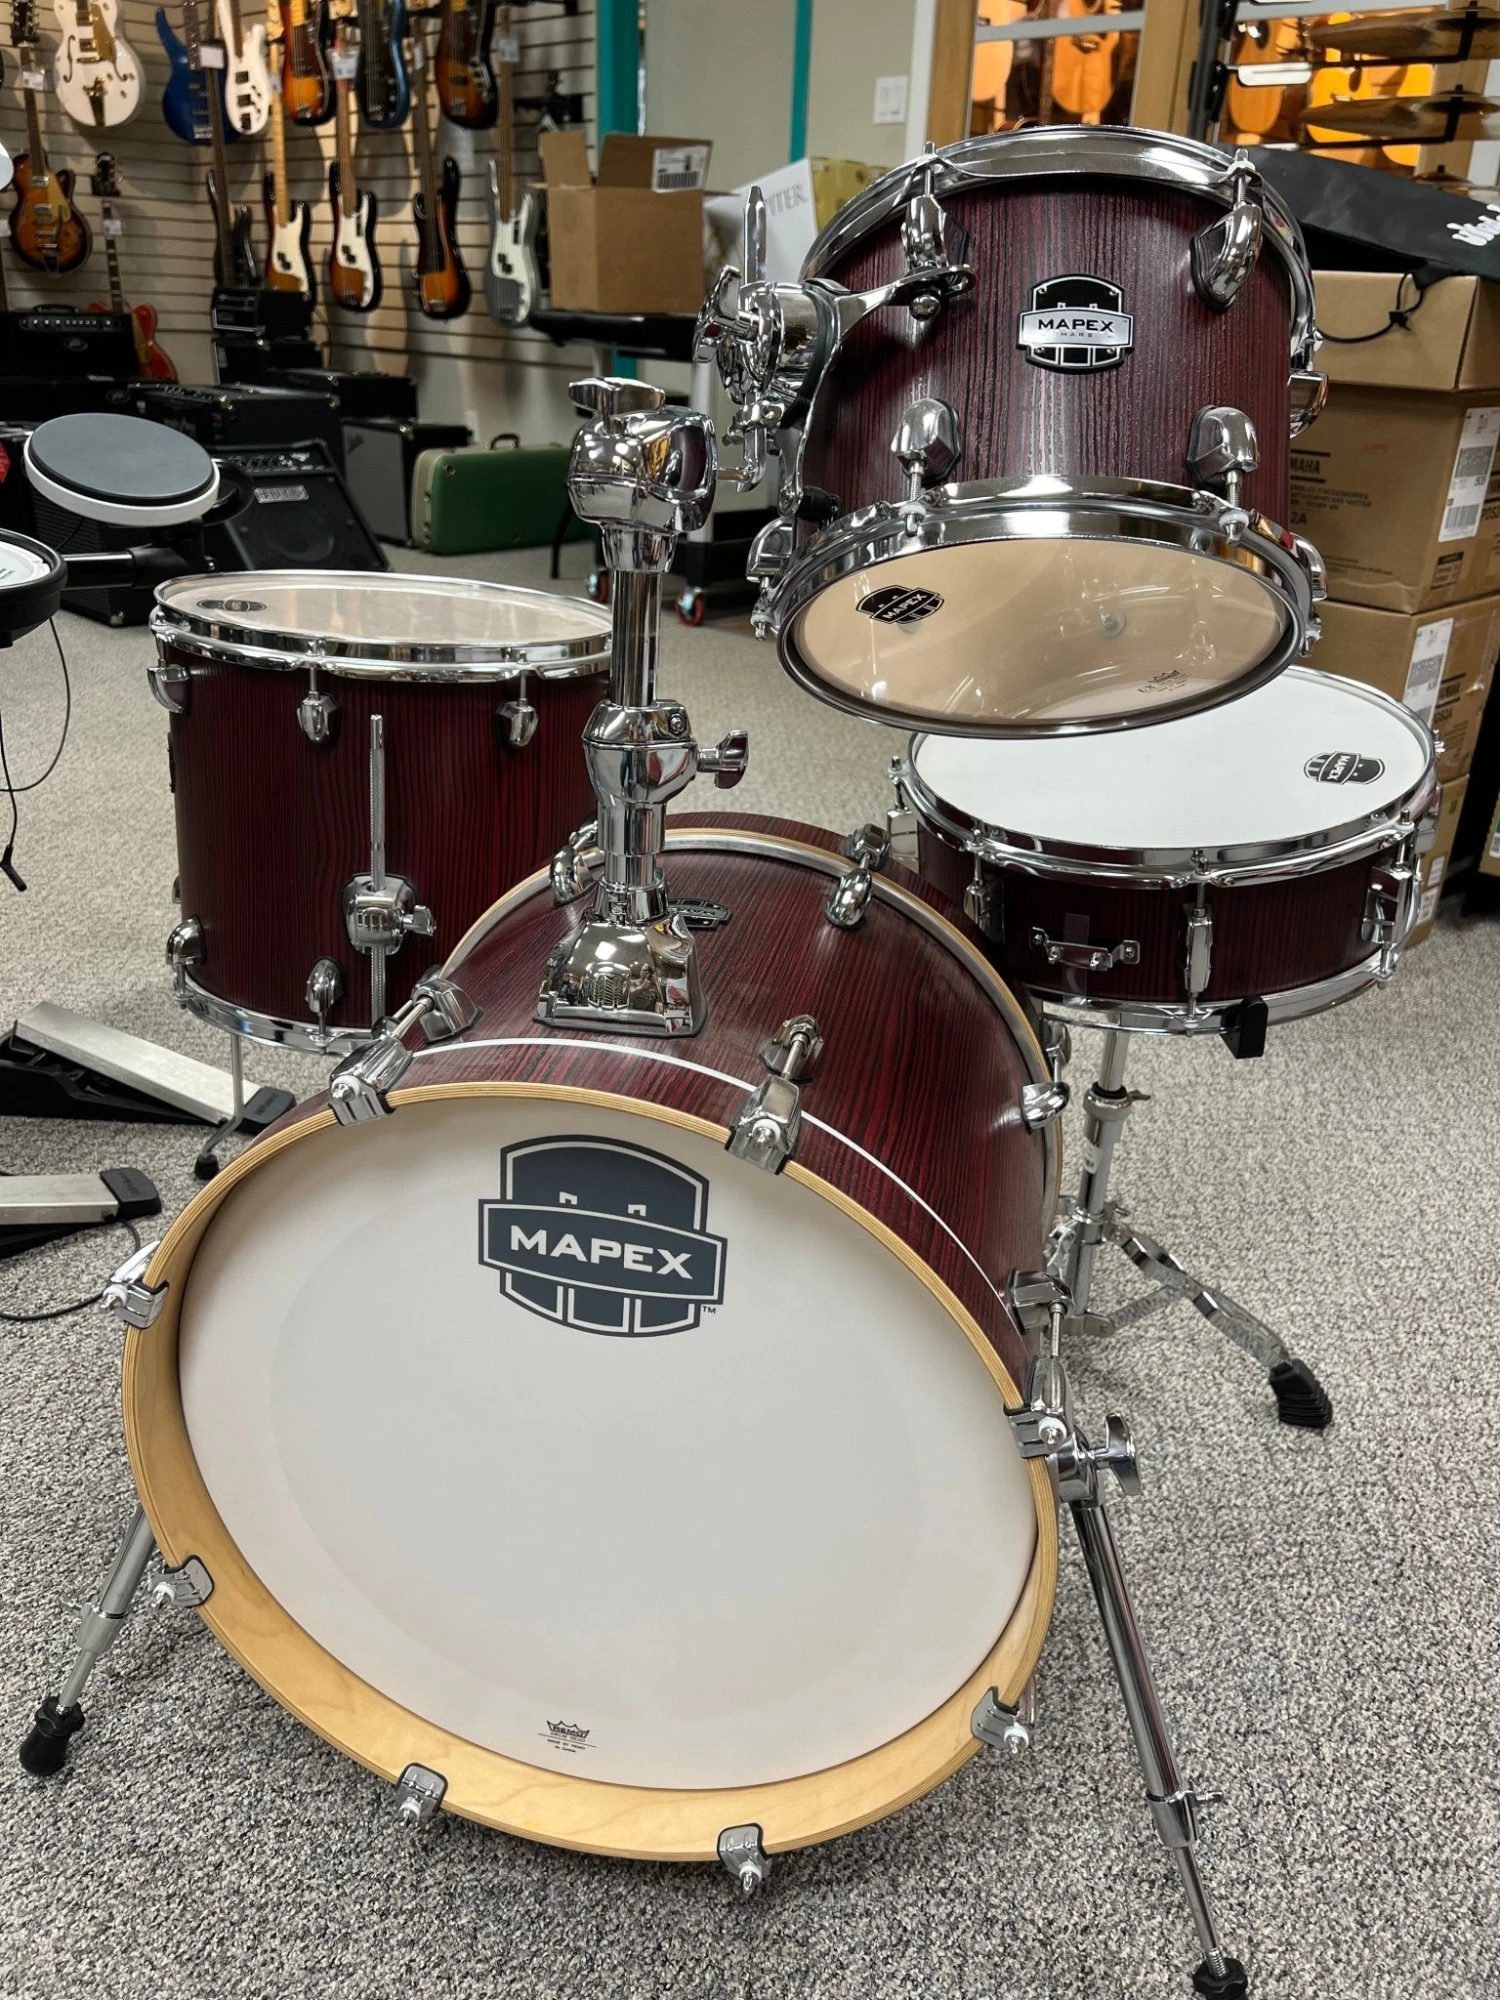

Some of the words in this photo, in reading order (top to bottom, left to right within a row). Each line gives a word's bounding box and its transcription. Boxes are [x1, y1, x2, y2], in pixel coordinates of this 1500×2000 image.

[1038, 318, 1115, 333] MAPEX
[1290, 457, 1320, 475] MAHA
[881, 593, 928, 619] MAPEX
[510, 1224, 694, 1280] MAPEX
[702, 1305, 716, 1315] TM
[553, 1725, 585, 1738] REMO
